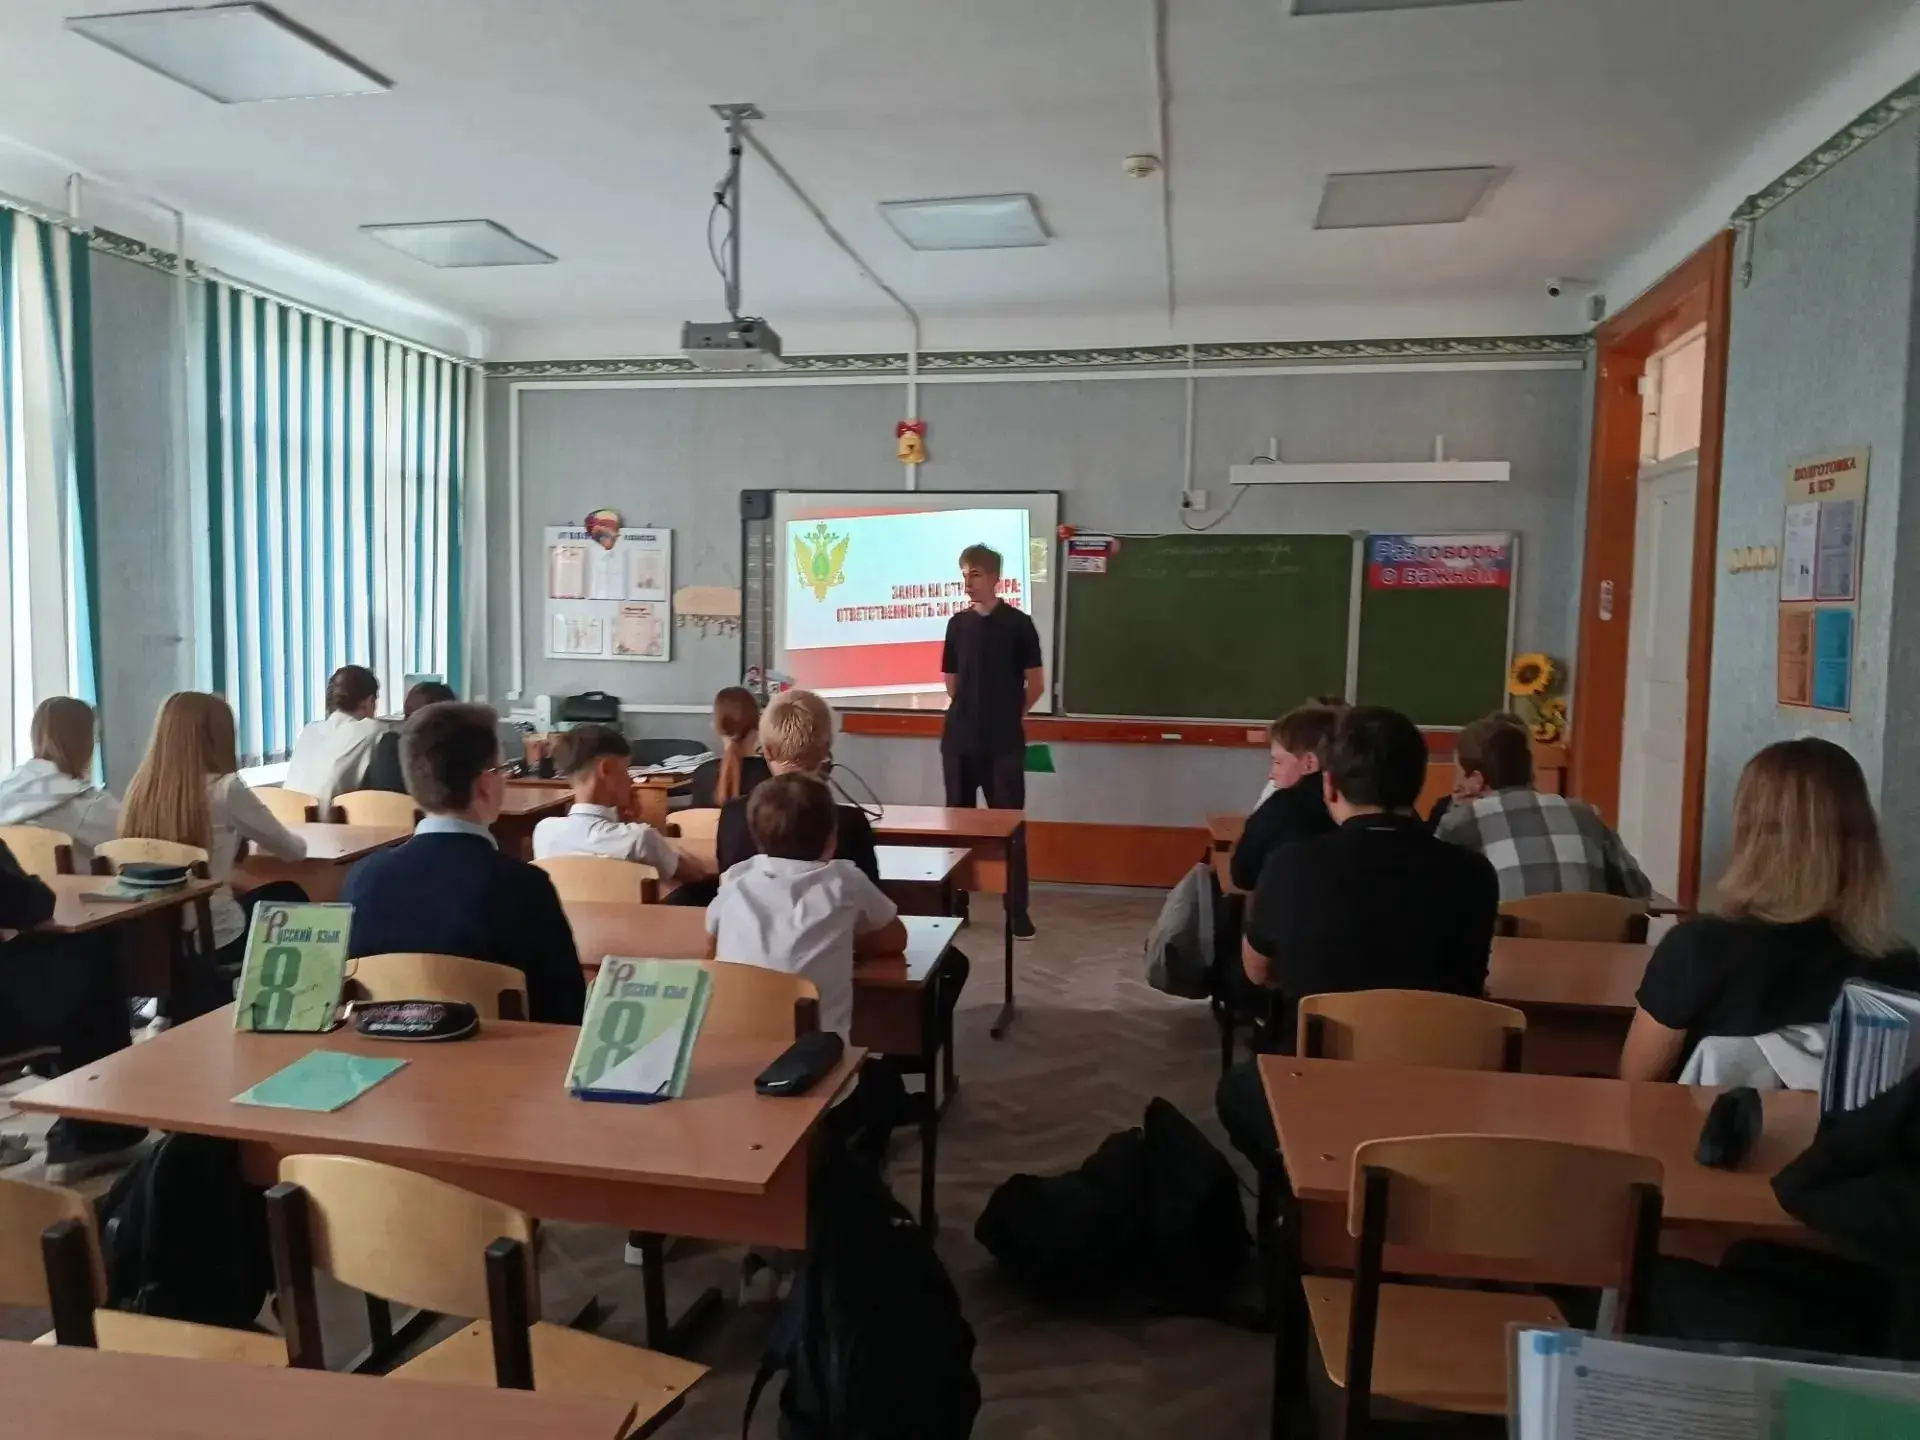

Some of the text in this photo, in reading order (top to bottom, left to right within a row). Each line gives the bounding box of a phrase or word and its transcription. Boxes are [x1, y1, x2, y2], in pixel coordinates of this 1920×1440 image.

[1793, 456, 1856, 481] ПОДГОТОВКА
[928, 582, 942, 598] НА
[836, 602, 935, 622] ОТВЕТСТВЕННОСТЬ
[937, 601, 951, 617] ЗА
[253, 946, 302, 1030] 8
